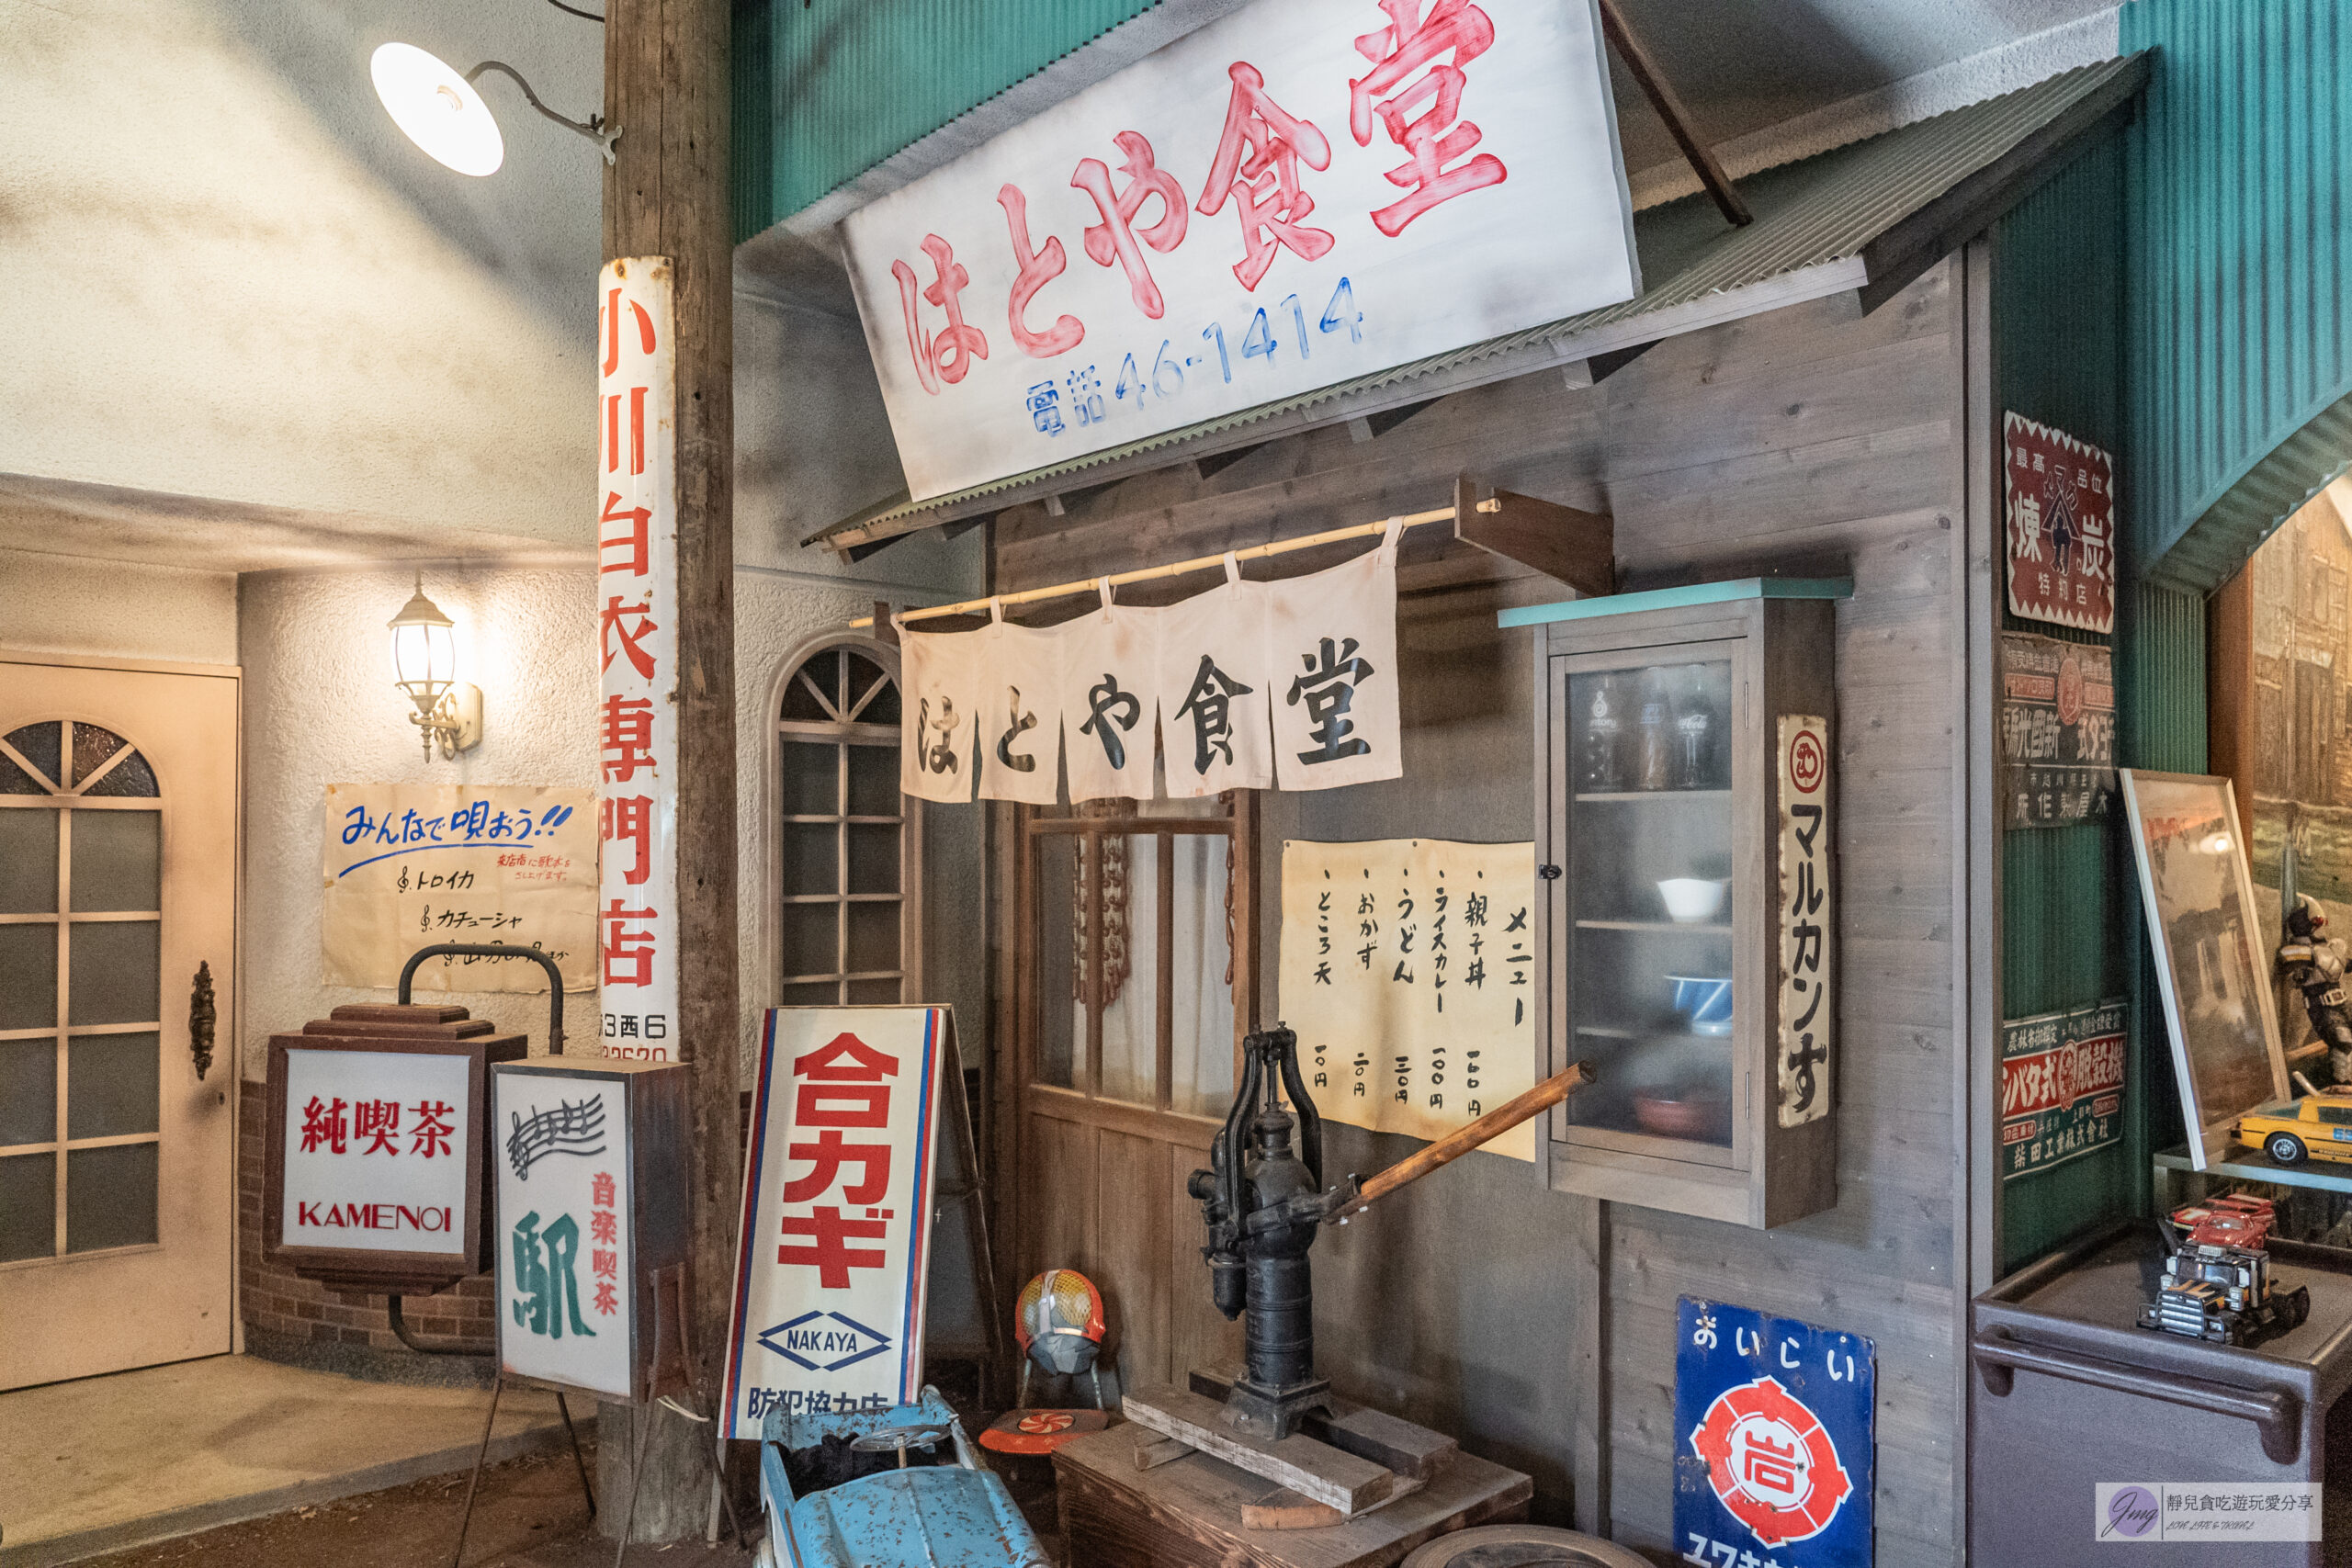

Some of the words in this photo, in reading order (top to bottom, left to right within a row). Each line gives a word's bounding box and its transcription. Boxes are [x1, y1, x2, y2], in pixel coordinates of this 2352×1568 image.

[891, 0, 1508, 396] はとや食堂
[918, 637, 1375, 775] はとや食堂
[417, 870, 474, 890] トロイカ
[435, 909, 523, 930] カチューシャ
[1313, 891, 1332, 986] ところ天
[1357, 893, 1378, 970] おかず
[1393, 888, 1417, 984] うどん
[1430, 887, 1449, 1013] ライスカレー
[1464, 891, 1487, 990] 親子丼
[1501, 907, 1533, 1027] メニュー
[598, 1013, 666, 1039] 3西6
[300, 1095, 456, 1159] 純喫茶
[777, 1032, 899, 1290] 合カギ
[298, 1201, 452, 1233] KAMENOI
[590, 1171, 619, 1316] 音楽喫茶
[786, 1329, 858, 1354] NAKAYA
[1693, 1315, 1854, 1382] おいしい
